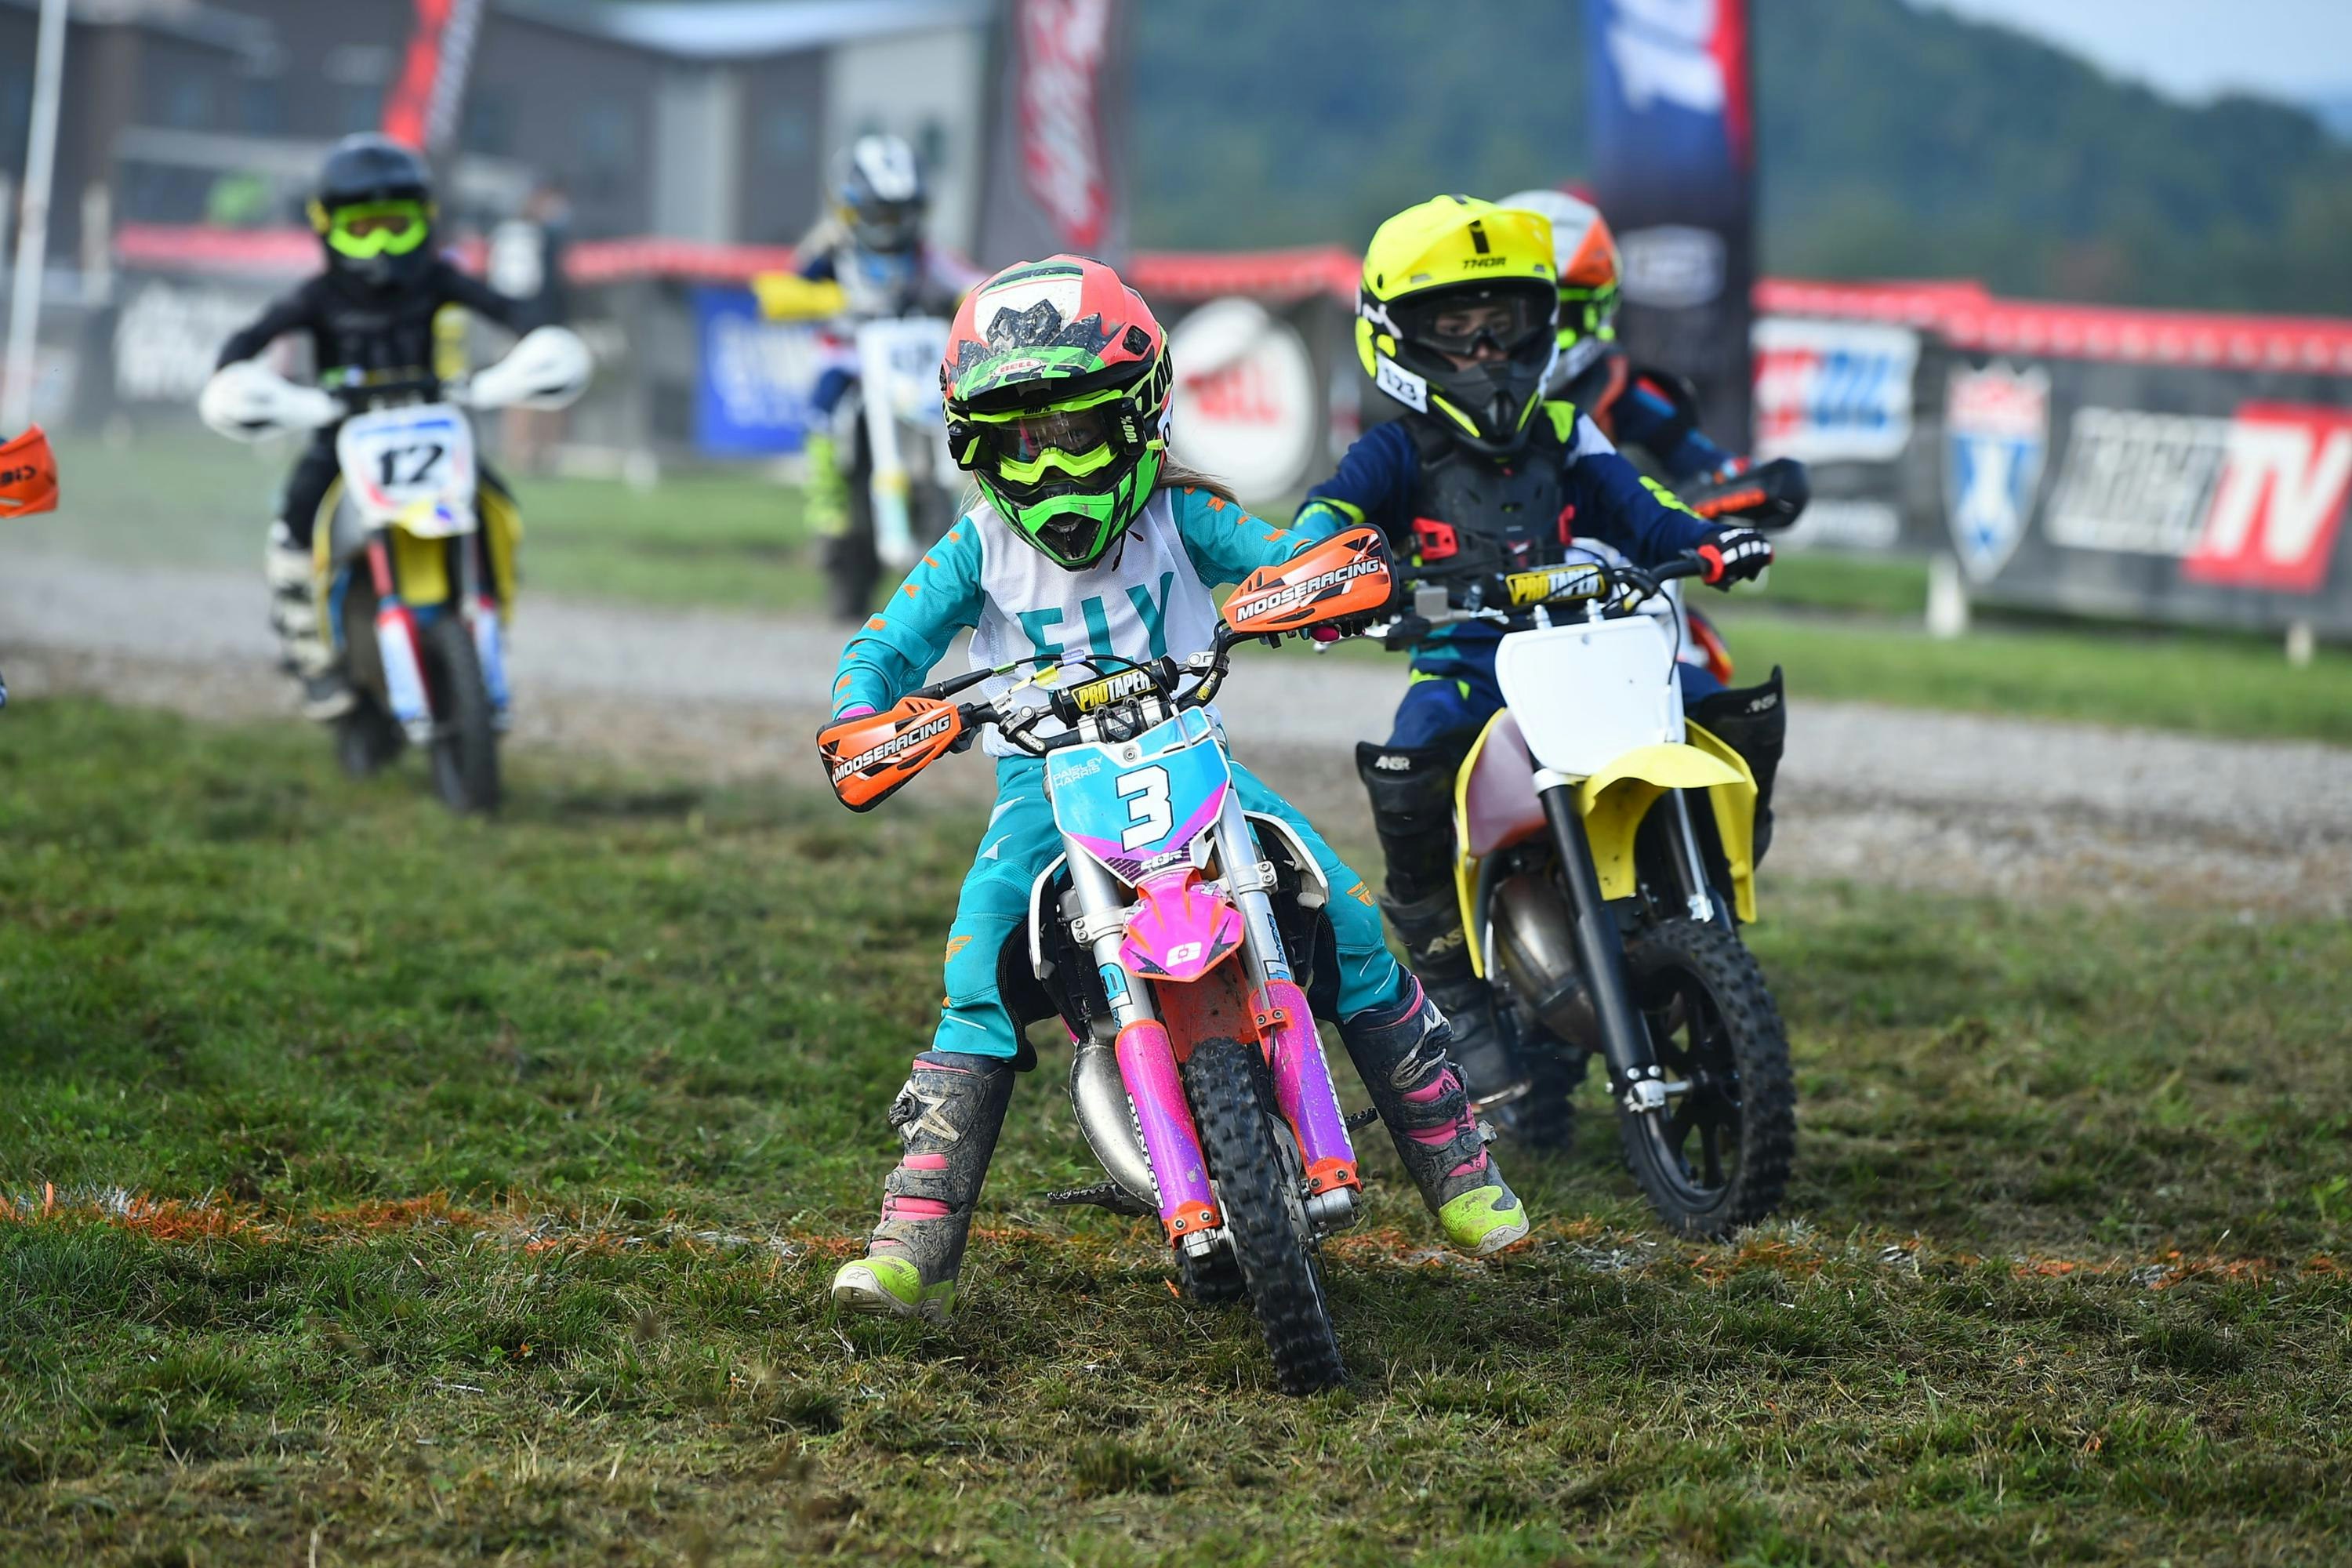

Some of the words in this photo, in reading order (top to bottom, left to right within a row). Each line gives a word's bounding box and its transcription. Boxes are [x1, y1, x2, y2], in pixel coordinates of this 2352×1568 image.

[1462, 257, 1506, 269] THOR
[1000, 361, 1034, 372] BELL
[1120, 415, 1138, 445] 100%
[380, 443, 444, 487] 12
[1236, 558, 1381, 623] MOOSERACING
[1015, 571, 1174, 695] FLY
[834, 713, 951, 782] MOOSERACING
[1052, 755, 1103, 781] PAISLEY
[1054, 765, 1101, 789] HARRIS
[1116, 764, 1174, 854] 3
